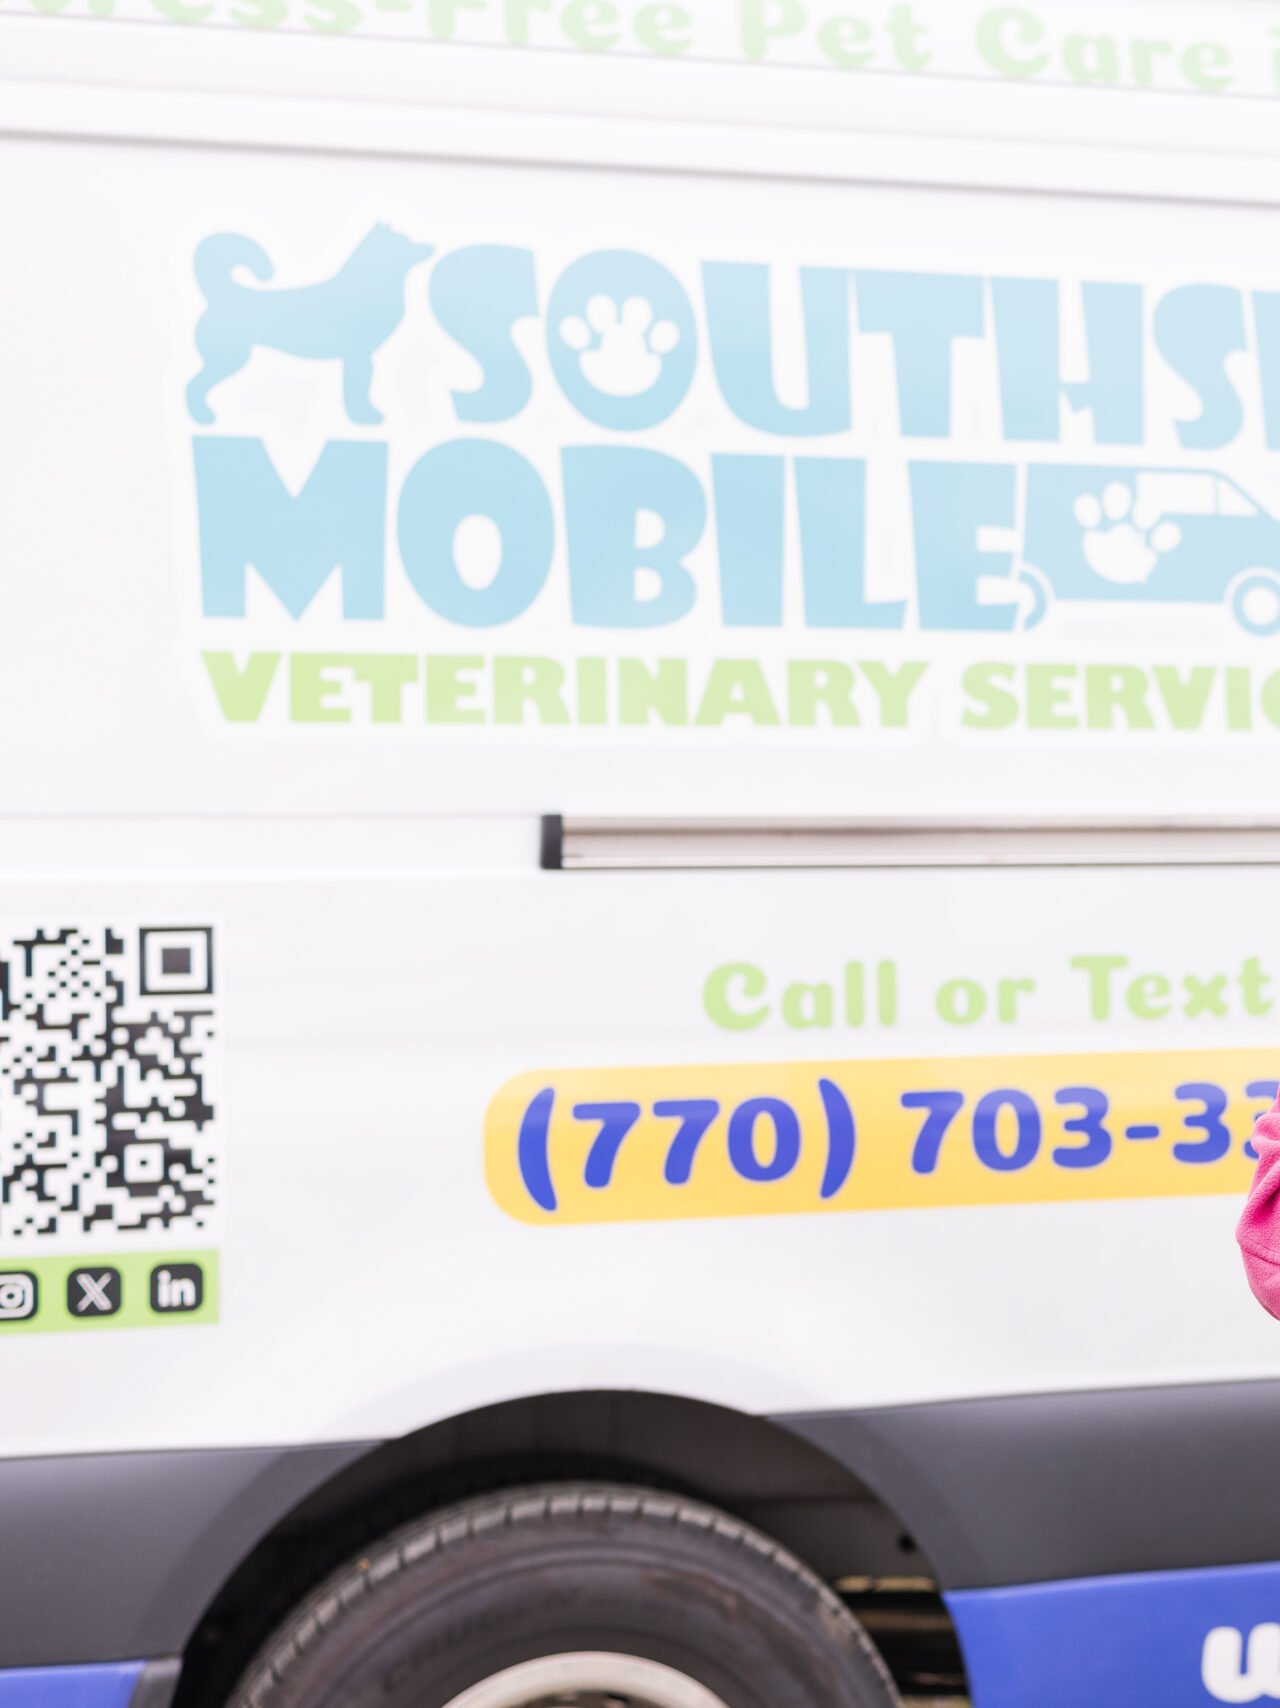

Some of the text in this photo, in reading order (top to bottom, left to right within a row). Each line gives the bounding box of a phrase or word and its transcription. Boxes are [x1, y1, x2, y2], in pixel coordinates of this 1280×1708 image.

[738, 0, 933, 72] Pet
[975, 6, 1234, 94] Care
[190, 433, 1021, 633] MOBILE
[200, 650, 929, 728] VETERINARY
[701, 953, 1274, 1033] Call or Text
[517, 1077, 857, 1212] (770)
